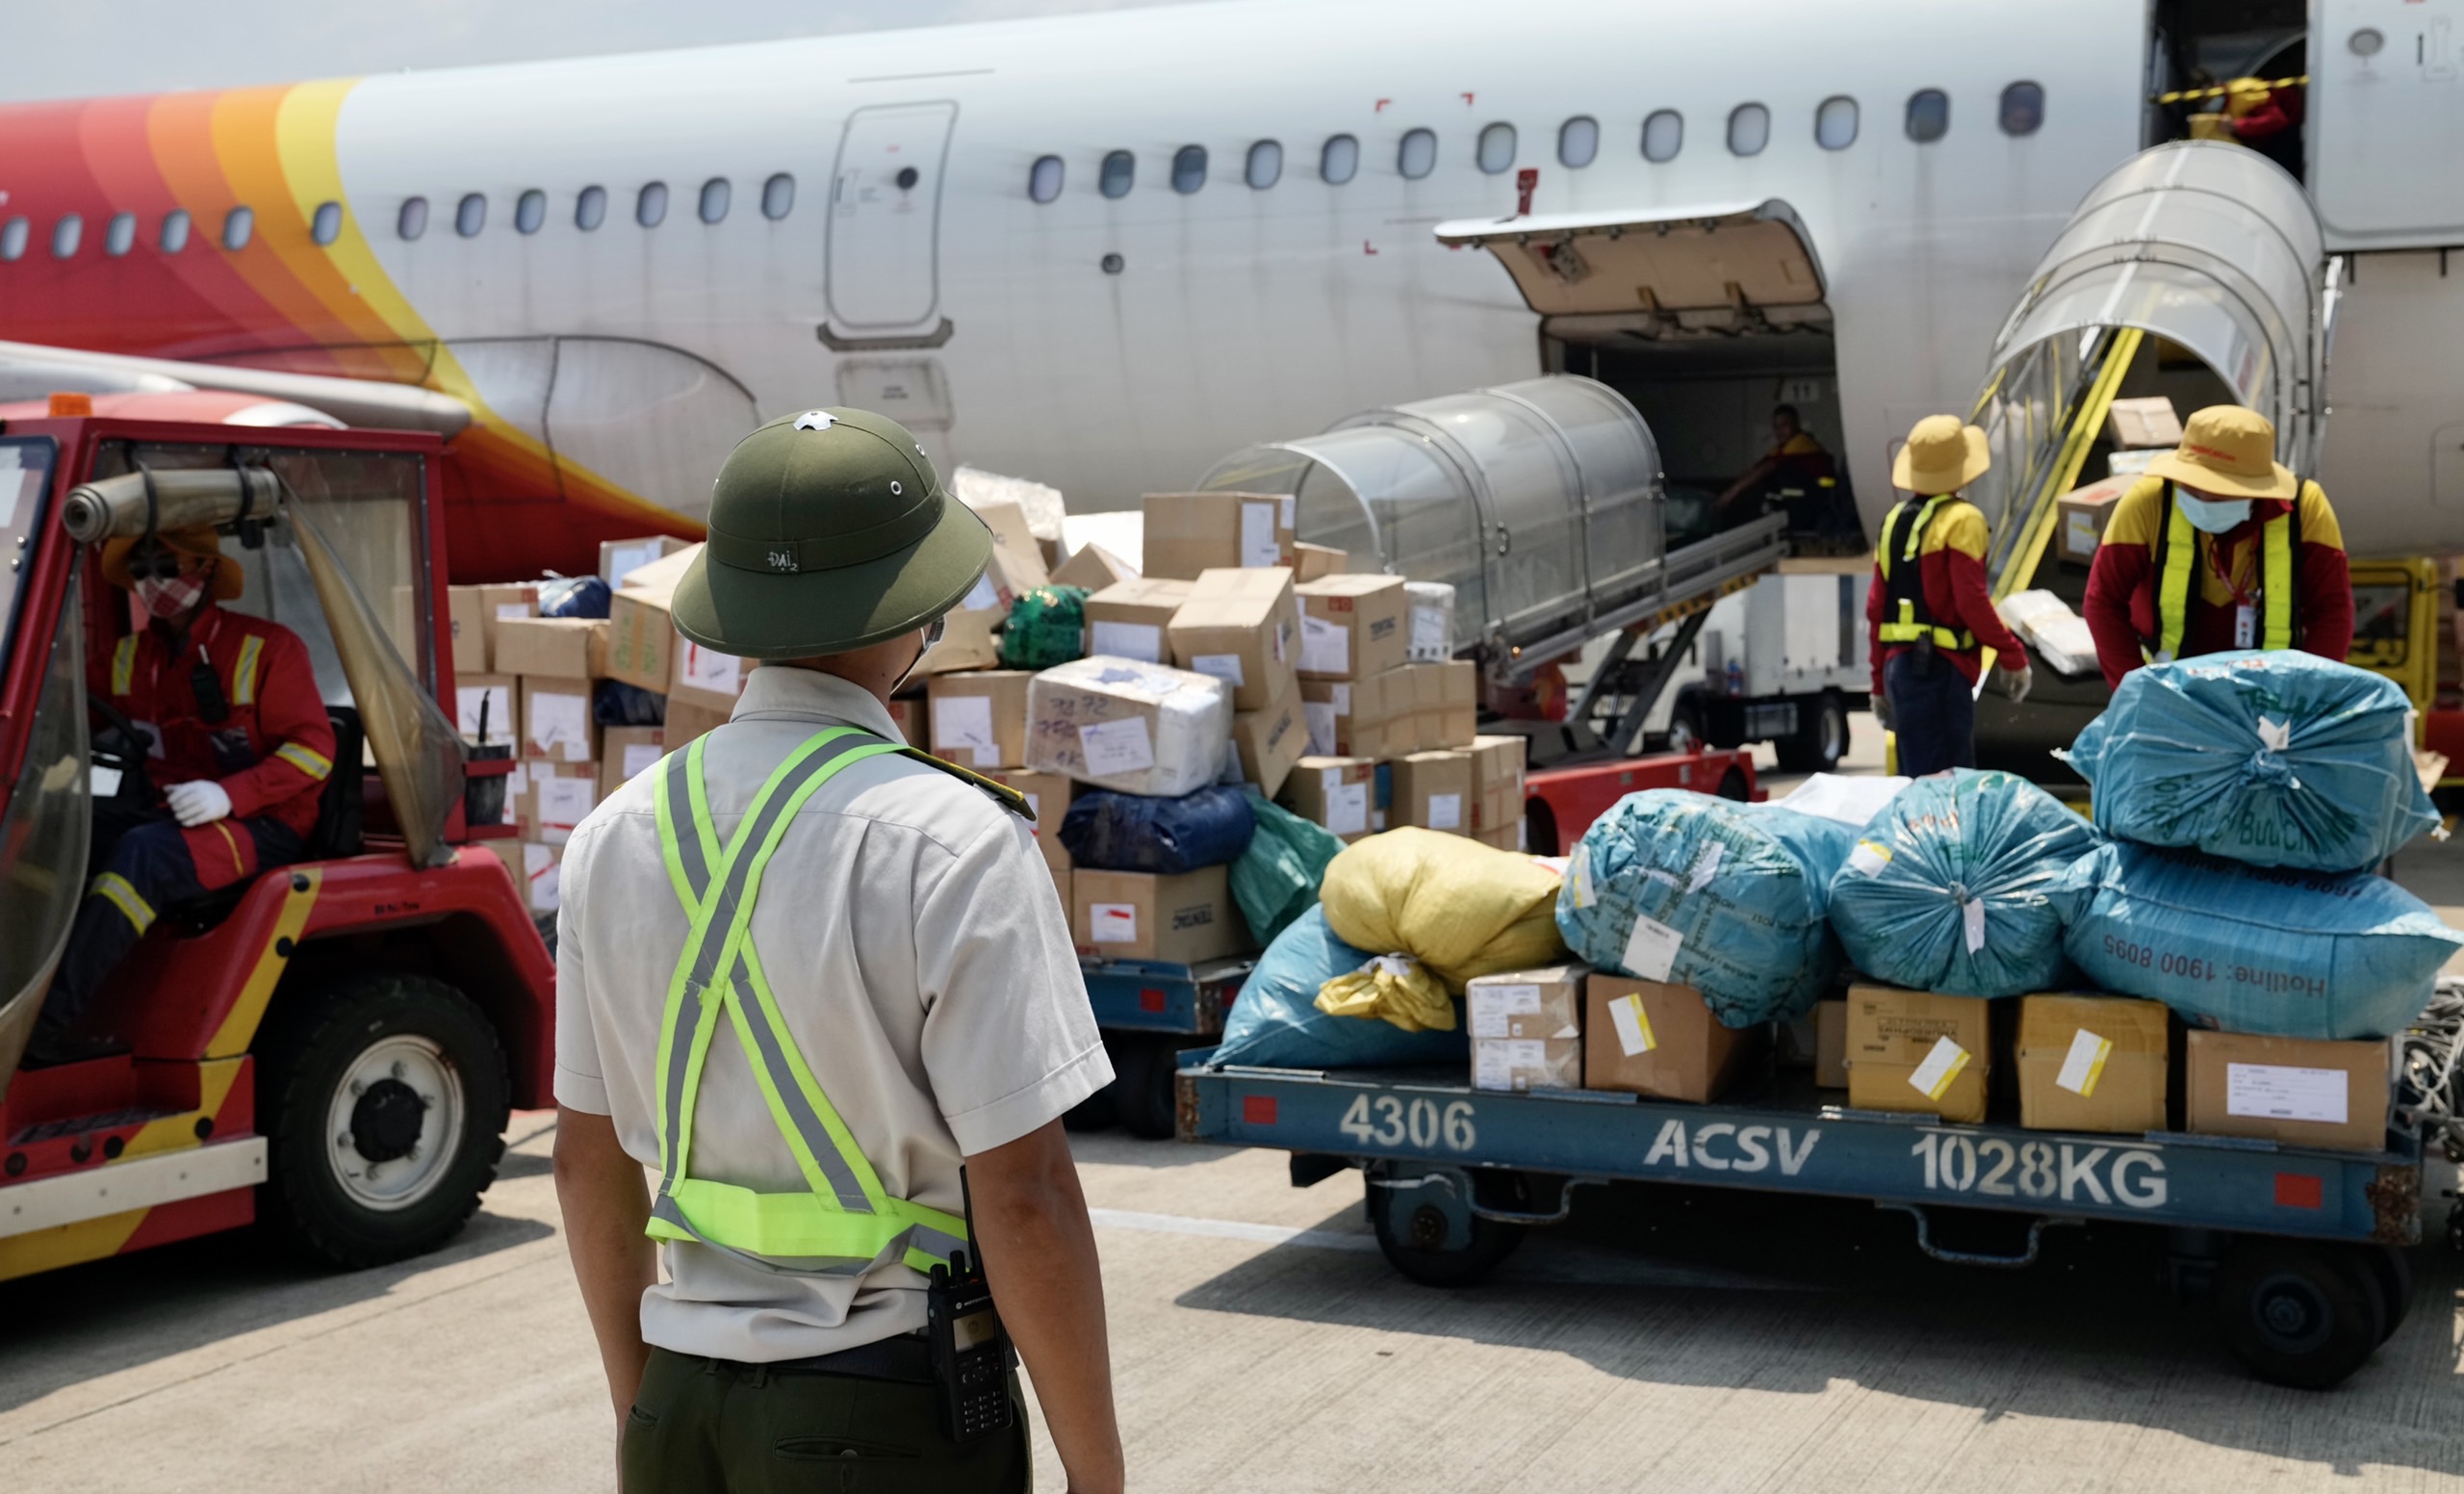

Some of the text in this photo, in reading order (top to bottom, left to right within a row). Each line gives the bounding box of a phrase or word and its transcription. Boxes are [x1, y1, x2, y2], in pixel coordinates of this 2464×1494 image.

[2104, 934, 2326, 997] Hotline: 1900 8095
[1340, 1093, 1476, 1152] 4306
[1643, 1119, 1822, 1176] ACSV
[1912, 1133, 2168, 1209] 1028KG
